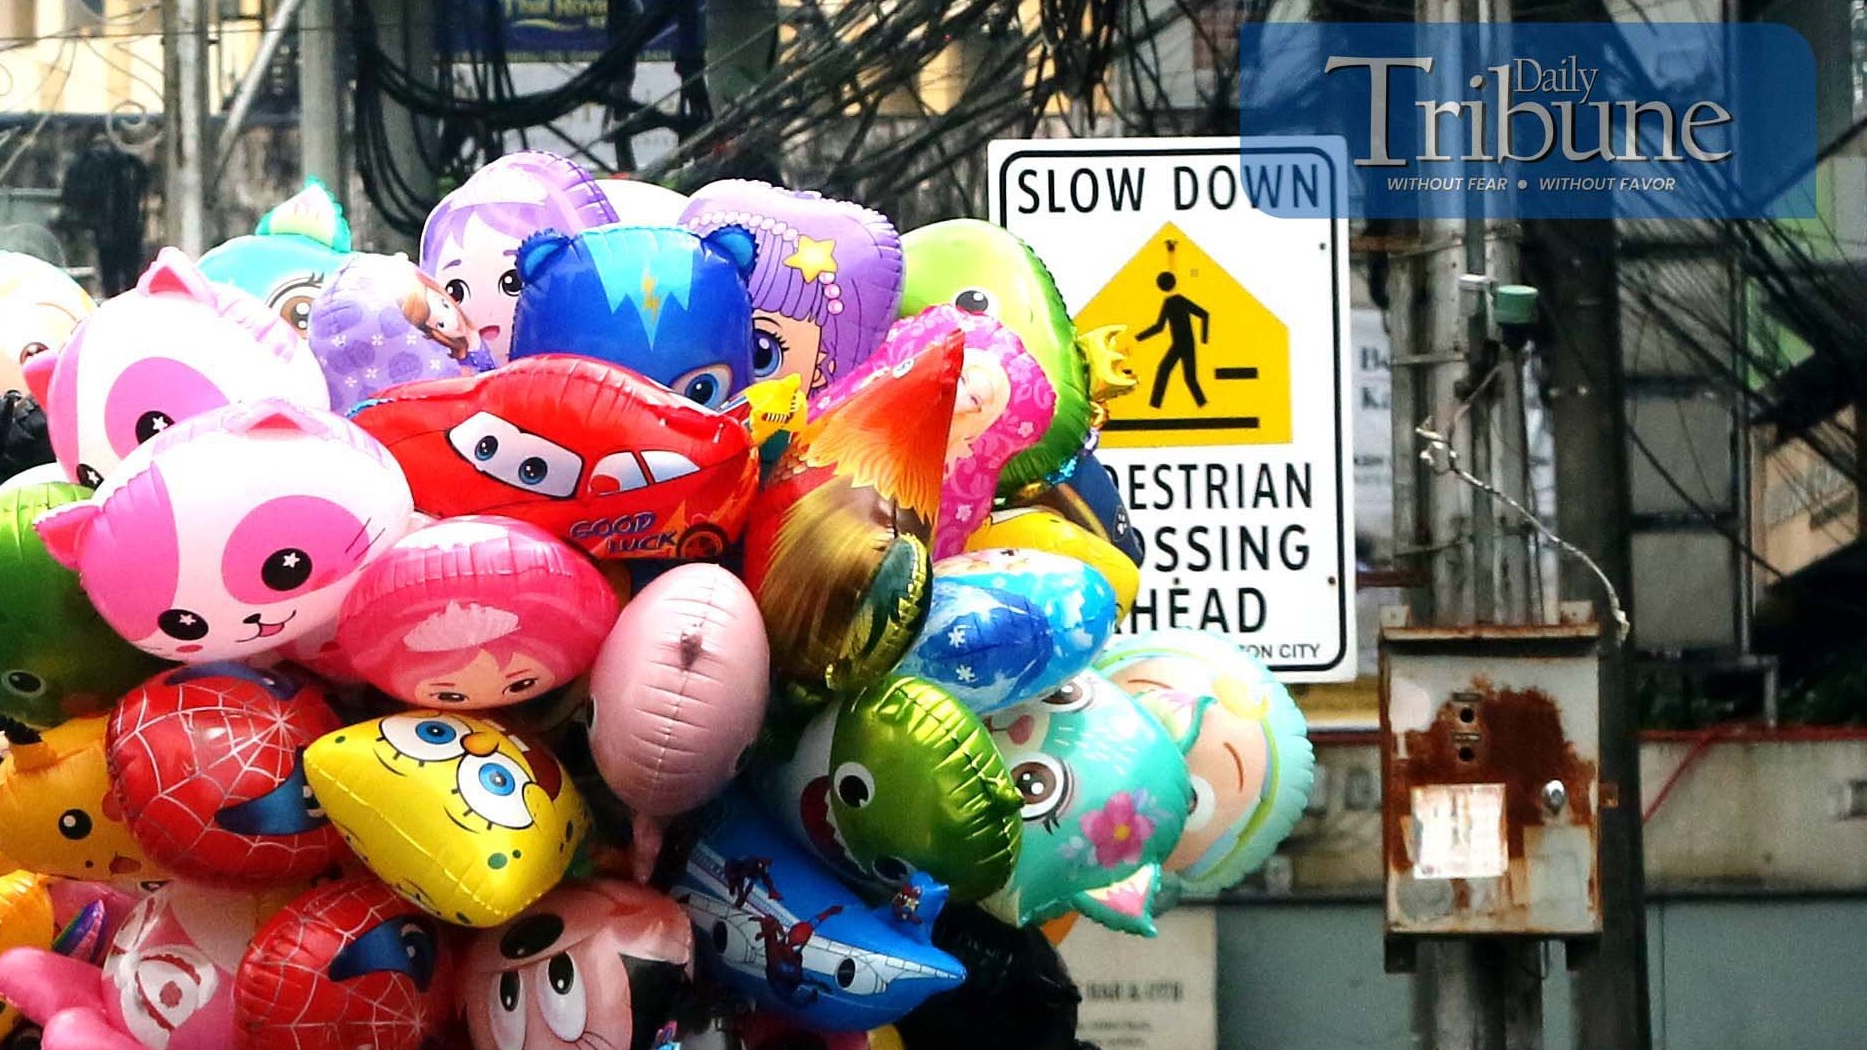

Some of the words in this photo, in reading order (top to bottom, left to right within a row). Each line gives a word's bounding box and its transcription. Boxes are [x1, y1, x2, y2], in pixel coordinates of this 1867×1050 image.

[1018, 166, 1146, 214] SLOW
[1174, 164, 1319, 210] DOWN
[570, 511, 656, 539] GOOD
[607, 530, 678, 553] LUCK
[1113, 586, 1267, 635] HEAD
[1279, 643, 1321, 659] CITY
